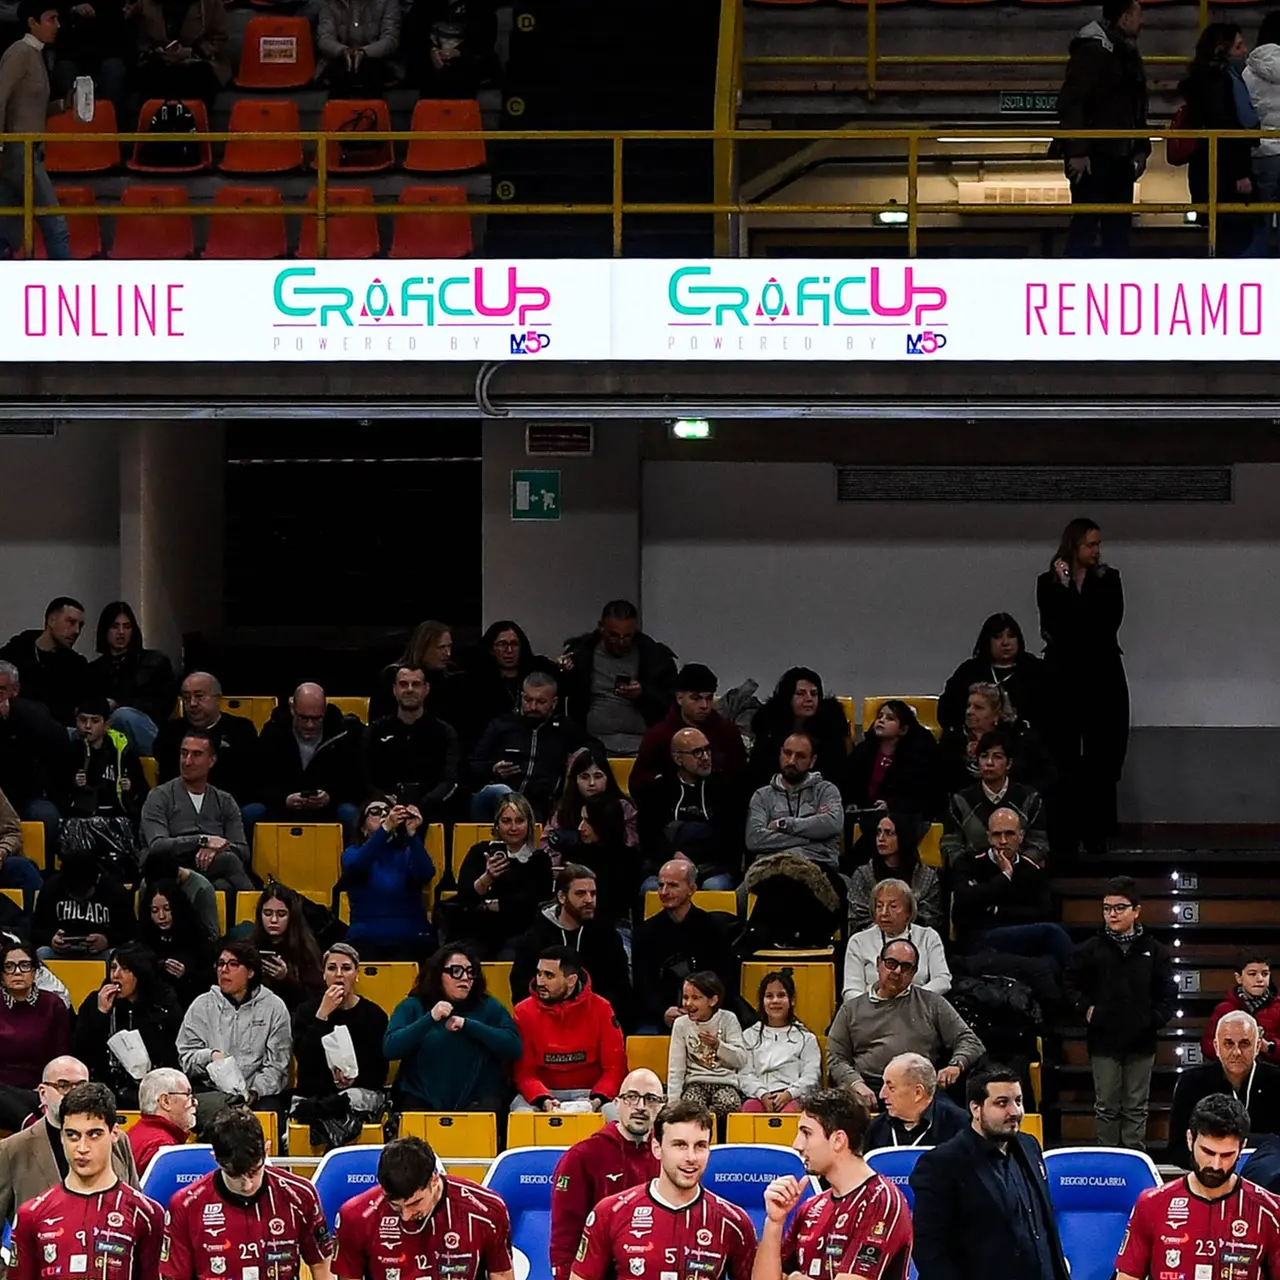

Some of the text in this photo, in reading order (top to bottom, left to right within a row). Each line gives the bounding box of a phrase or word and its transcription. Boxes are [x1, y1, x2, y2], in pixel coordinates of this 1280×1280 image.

[24, 284, 183, 336] ONLINE
[1026, 283, 1263, 336] RENDIAMO
[273, 336, 481, 350] POWERED BY
[668, 336, 877, 350] POWERED BY
[346, 1174, 373, 1183] REGGIO
[520, 1174, 548, 1184] REGGIO
[714, 1173, 780, 1183] REGGIO CALABRI
[1060, 1176, 1126, 1187] REGGIO CALABRIA
[75, 1231, 86, 1247] 9
[238, 1242, 260, 1260] 29
[1195, 1239, 1217, 1257] 23
[414, 1255, 433, 1270] 12
[664, 1248, 677, 1264] 5
